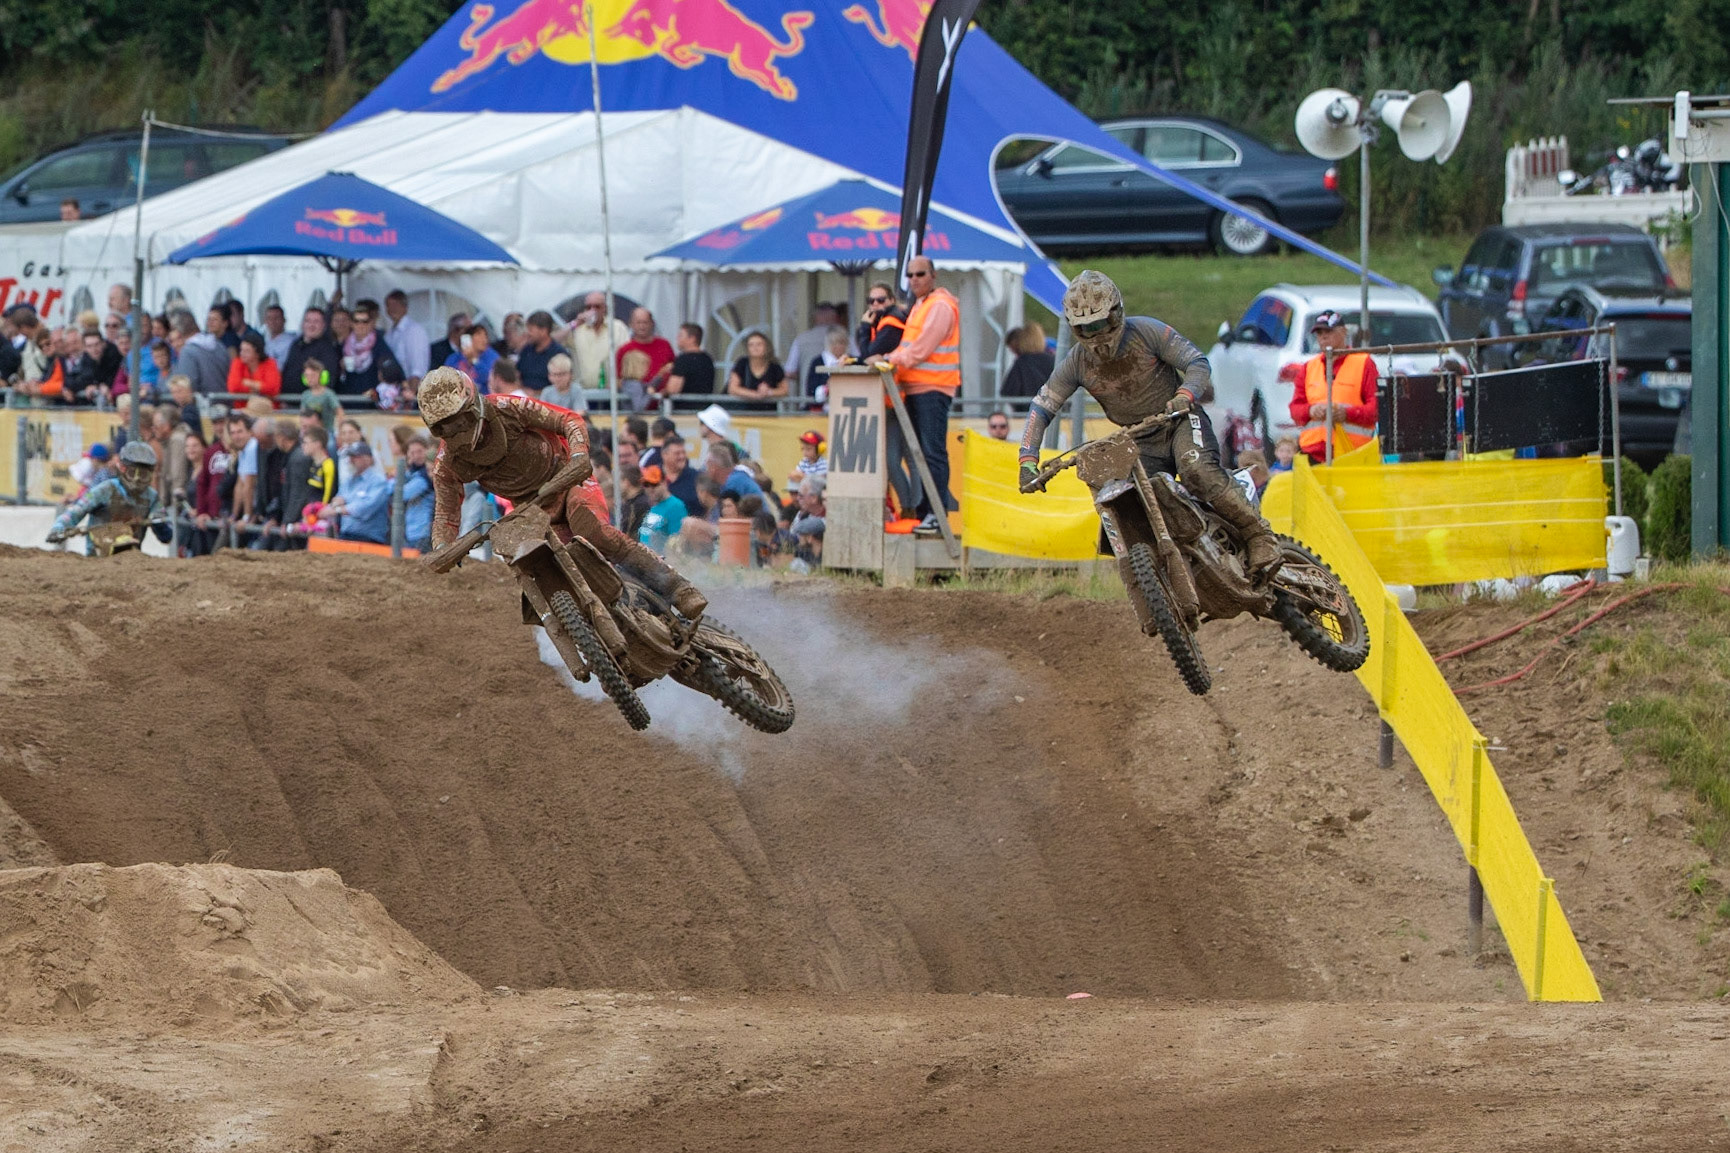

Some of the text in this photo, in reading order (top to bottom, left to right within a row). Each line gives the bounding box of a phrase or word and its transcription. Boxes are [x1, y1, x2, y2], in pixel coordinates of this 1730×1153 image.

[295, 220, 398, 246] Red Bull
[807, 231, 879, 250] Red
[829, 397, 879, 473] KTM
